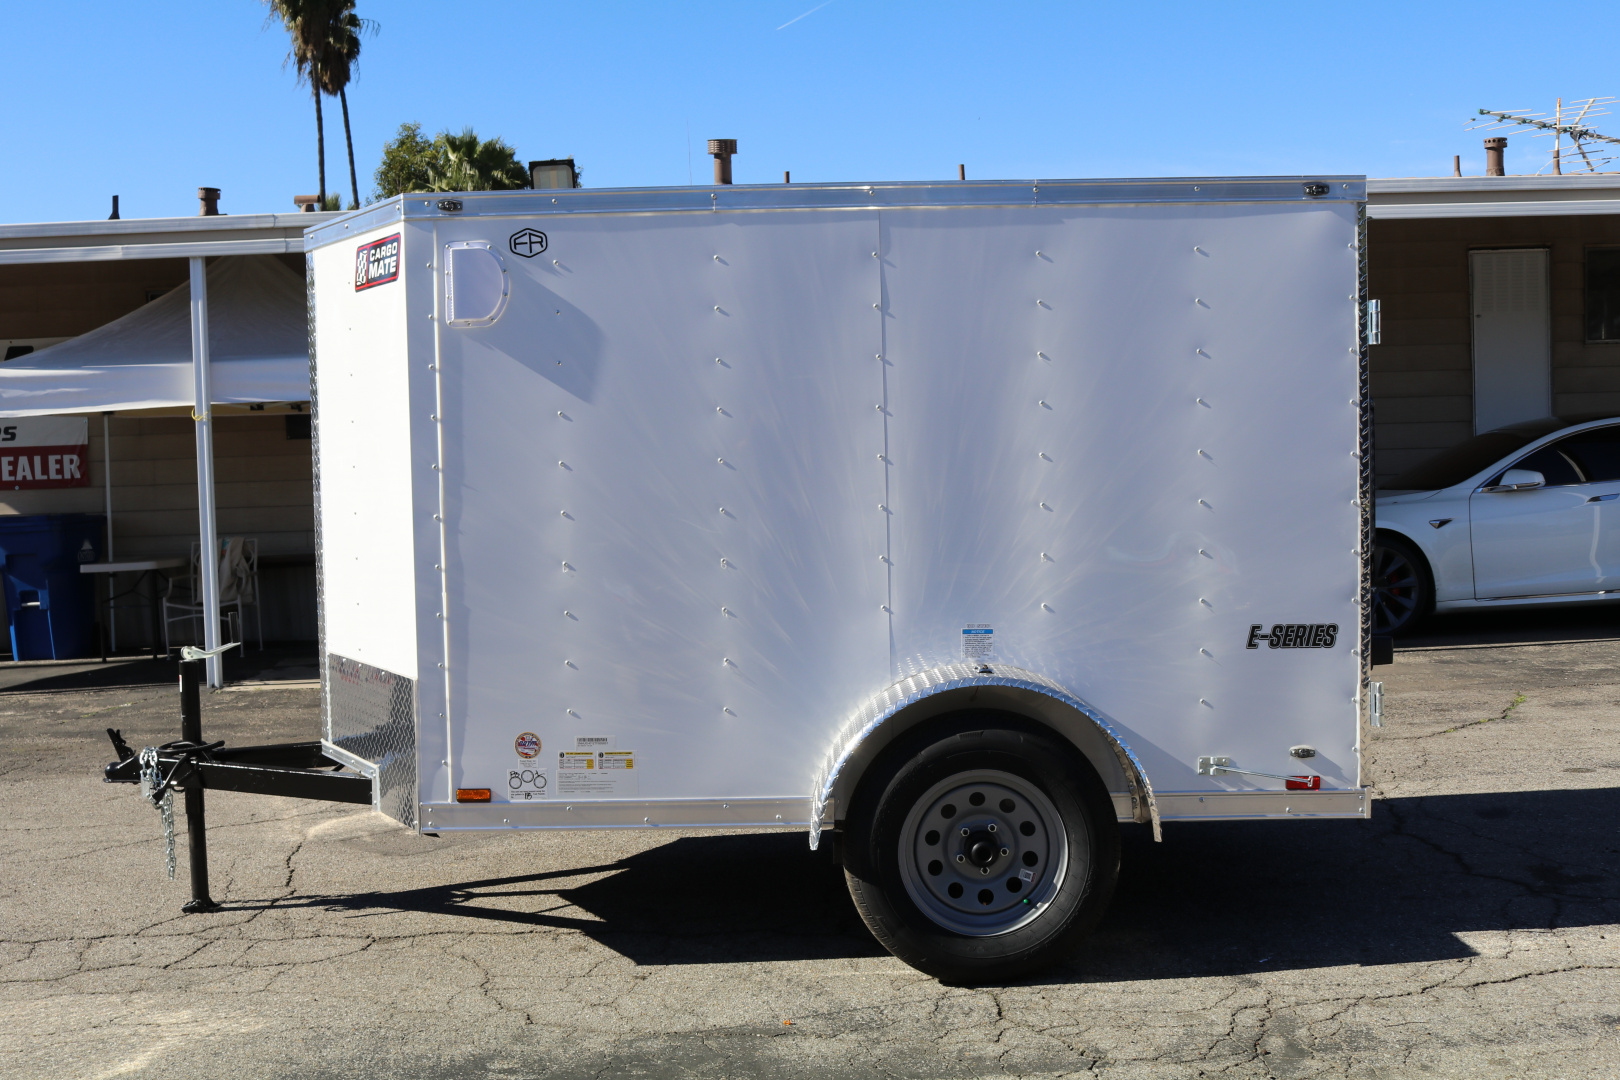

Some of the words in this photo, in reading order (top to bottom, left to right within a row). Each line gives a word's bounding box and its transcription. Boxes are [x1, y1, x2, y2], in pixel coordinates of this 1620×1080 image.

[370, 242, 398, 262] CARGO
[369, 255, 397, 280] MATE
[1, 454, 81, 481] EALER
[1246, 623, 1339, 649] E-SERIES
